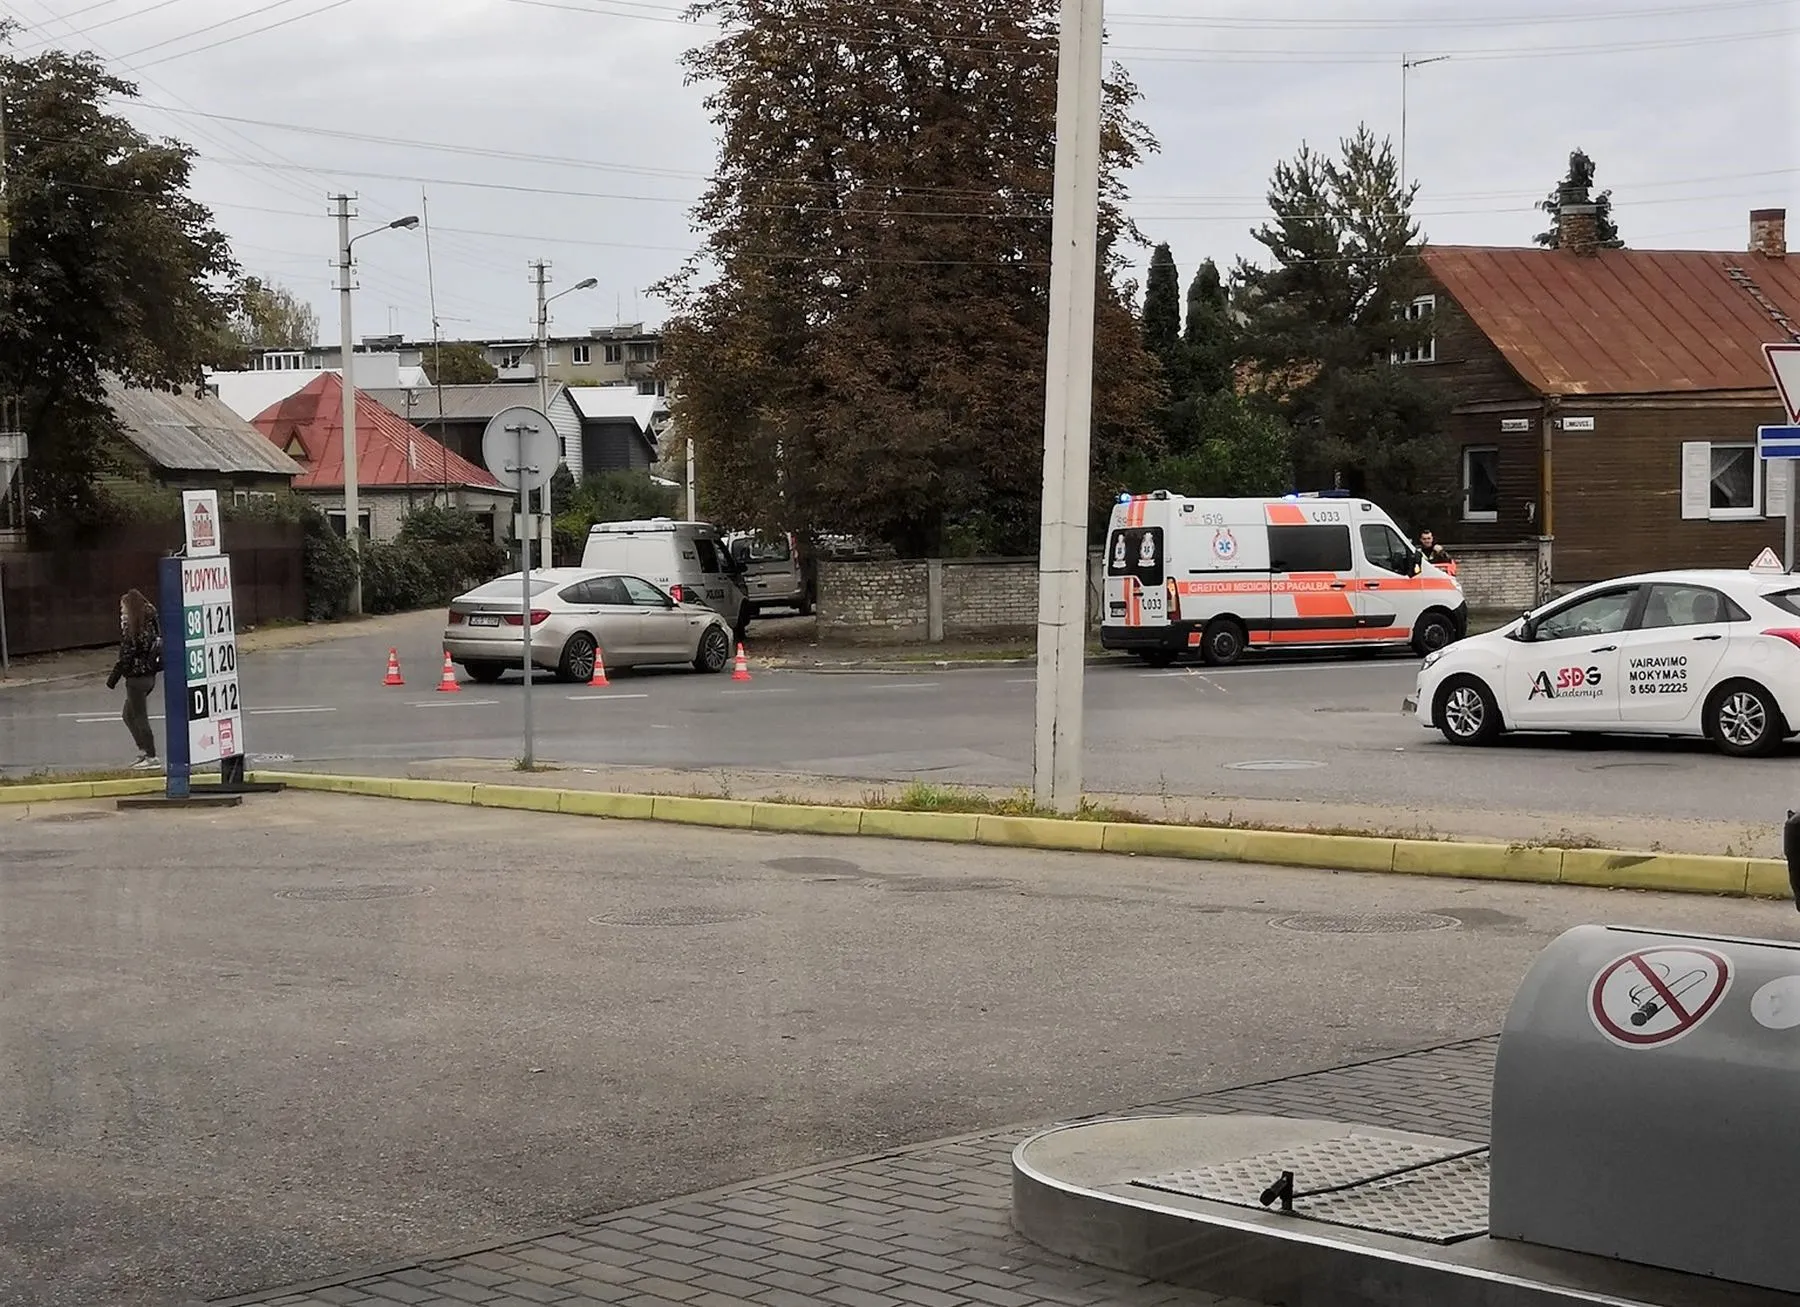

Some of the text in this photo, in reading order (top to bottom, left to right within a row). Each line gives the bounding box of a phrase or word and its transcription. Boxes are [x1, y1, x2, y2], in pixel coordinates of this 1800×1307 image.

[1202, 513, 1223, 525] 1519
[1320, 511, 1340, 522] 033
[184, 567, 229, 593] PLOVYKLA
[1189, 583, 1232, 593] GREITOJI
[1146, 599, 1162, 610] 033
[188, 606, 232, 635] 98 1.21
[189, 644, 235, 674] 95 1.20
[1629, 656, 1688, 668] VAIRAVIMO
[1629, 669, 1687, 680] MOKYMAS
[1629, 683, 1688, 694] 8 650 22225
[194, 683, 238, 714] D 1.12
